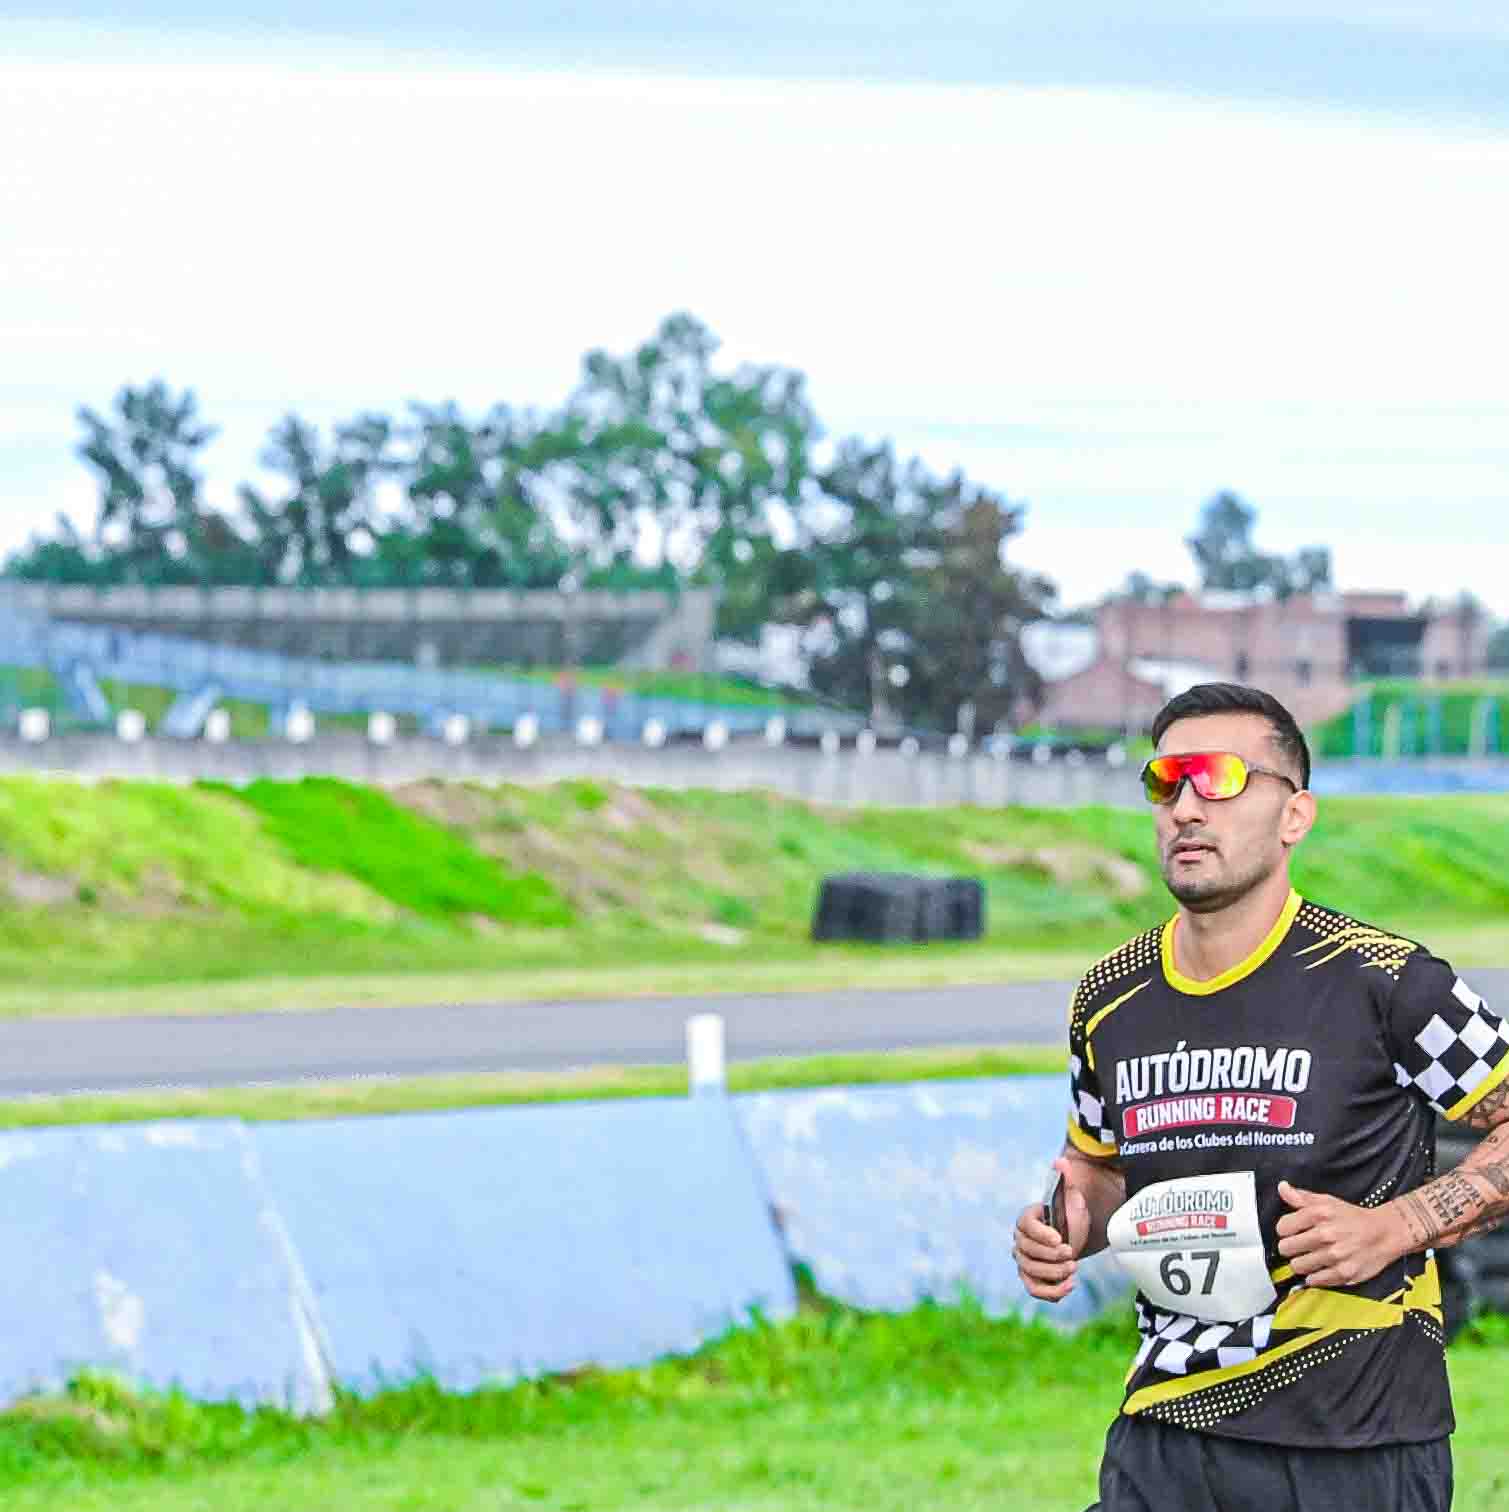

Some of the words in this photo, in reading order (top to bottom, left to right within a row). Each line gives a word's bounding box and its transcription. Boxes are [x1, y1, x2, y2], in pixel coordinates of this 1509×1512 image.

[1115, 1040, 1312, 1105] AUTÓDROMO
[1136, 1097, 1216, 1132] RUNNING
[1221, 1095, 1271, 1123] RACE
[1159, 1136, 1175, 1151] de
[1175, 1135, 1194, 1150] los
[1194, 1132, 1234, 1148] Clubes
[1235, 1130, 1252, 1146] del
[1254, 1130, 1315, 1146] Noroeste
[1160, 1250, 1220, 1296] 67
